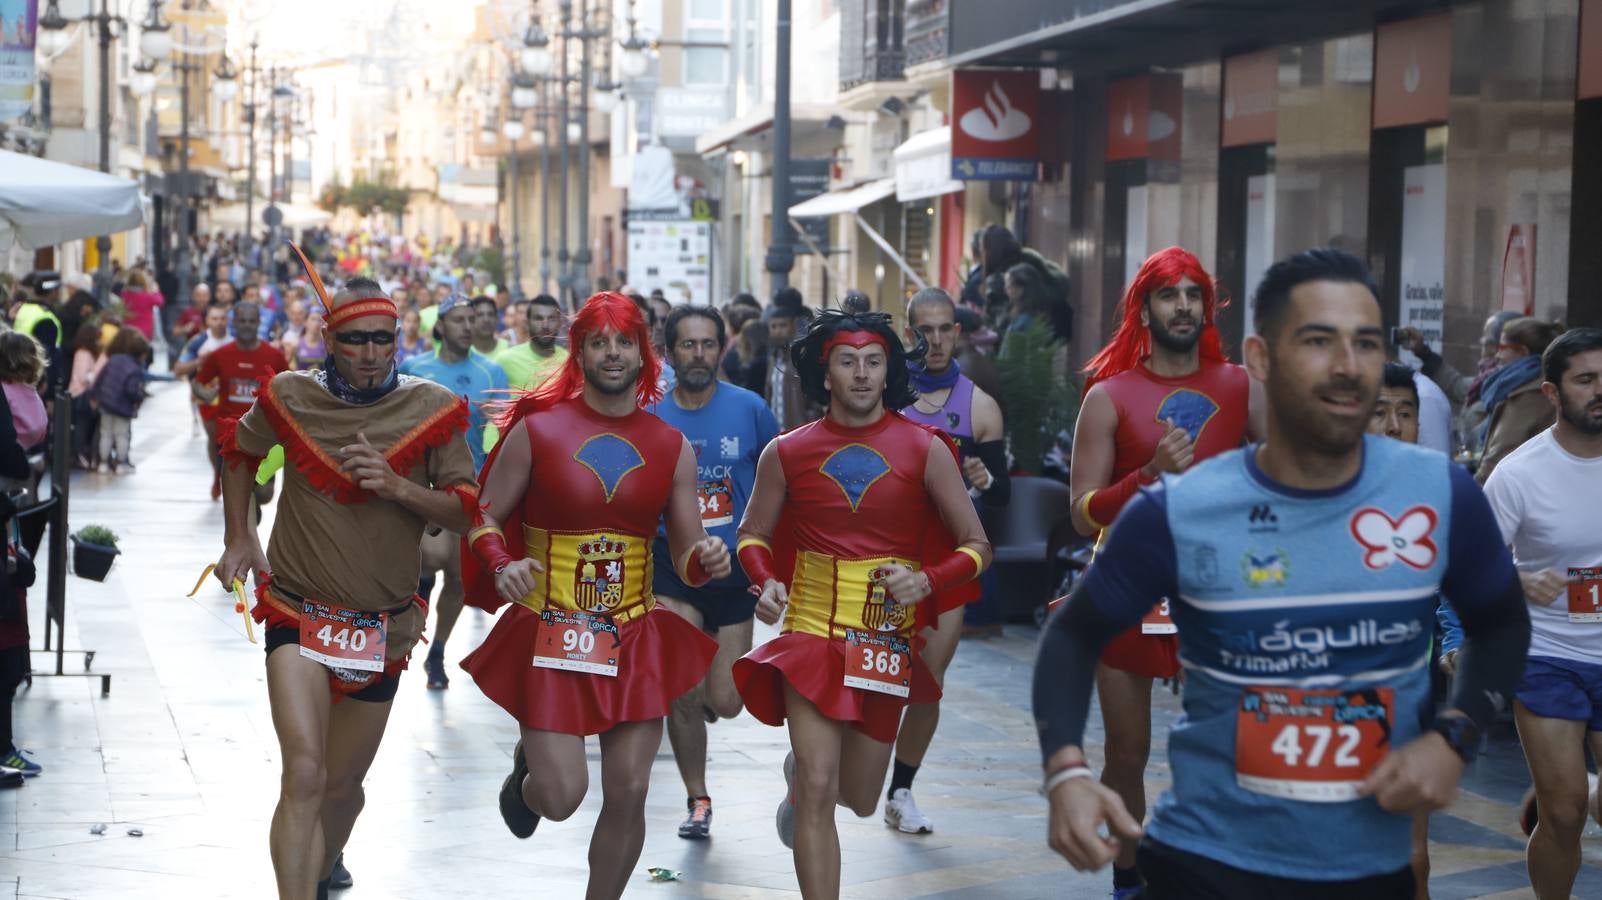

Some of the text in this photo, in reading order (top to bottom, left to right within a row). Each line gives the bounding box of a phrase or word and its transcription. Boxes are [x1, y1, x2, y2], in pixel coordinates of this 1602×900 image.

[316, 604, 330, 612] SAN
[316, 624, 367, 652] 440
[563, 629, 595, 653] 90
[862, 648, 901, 676] 368
[1271, 724, 1361, 767] 472
